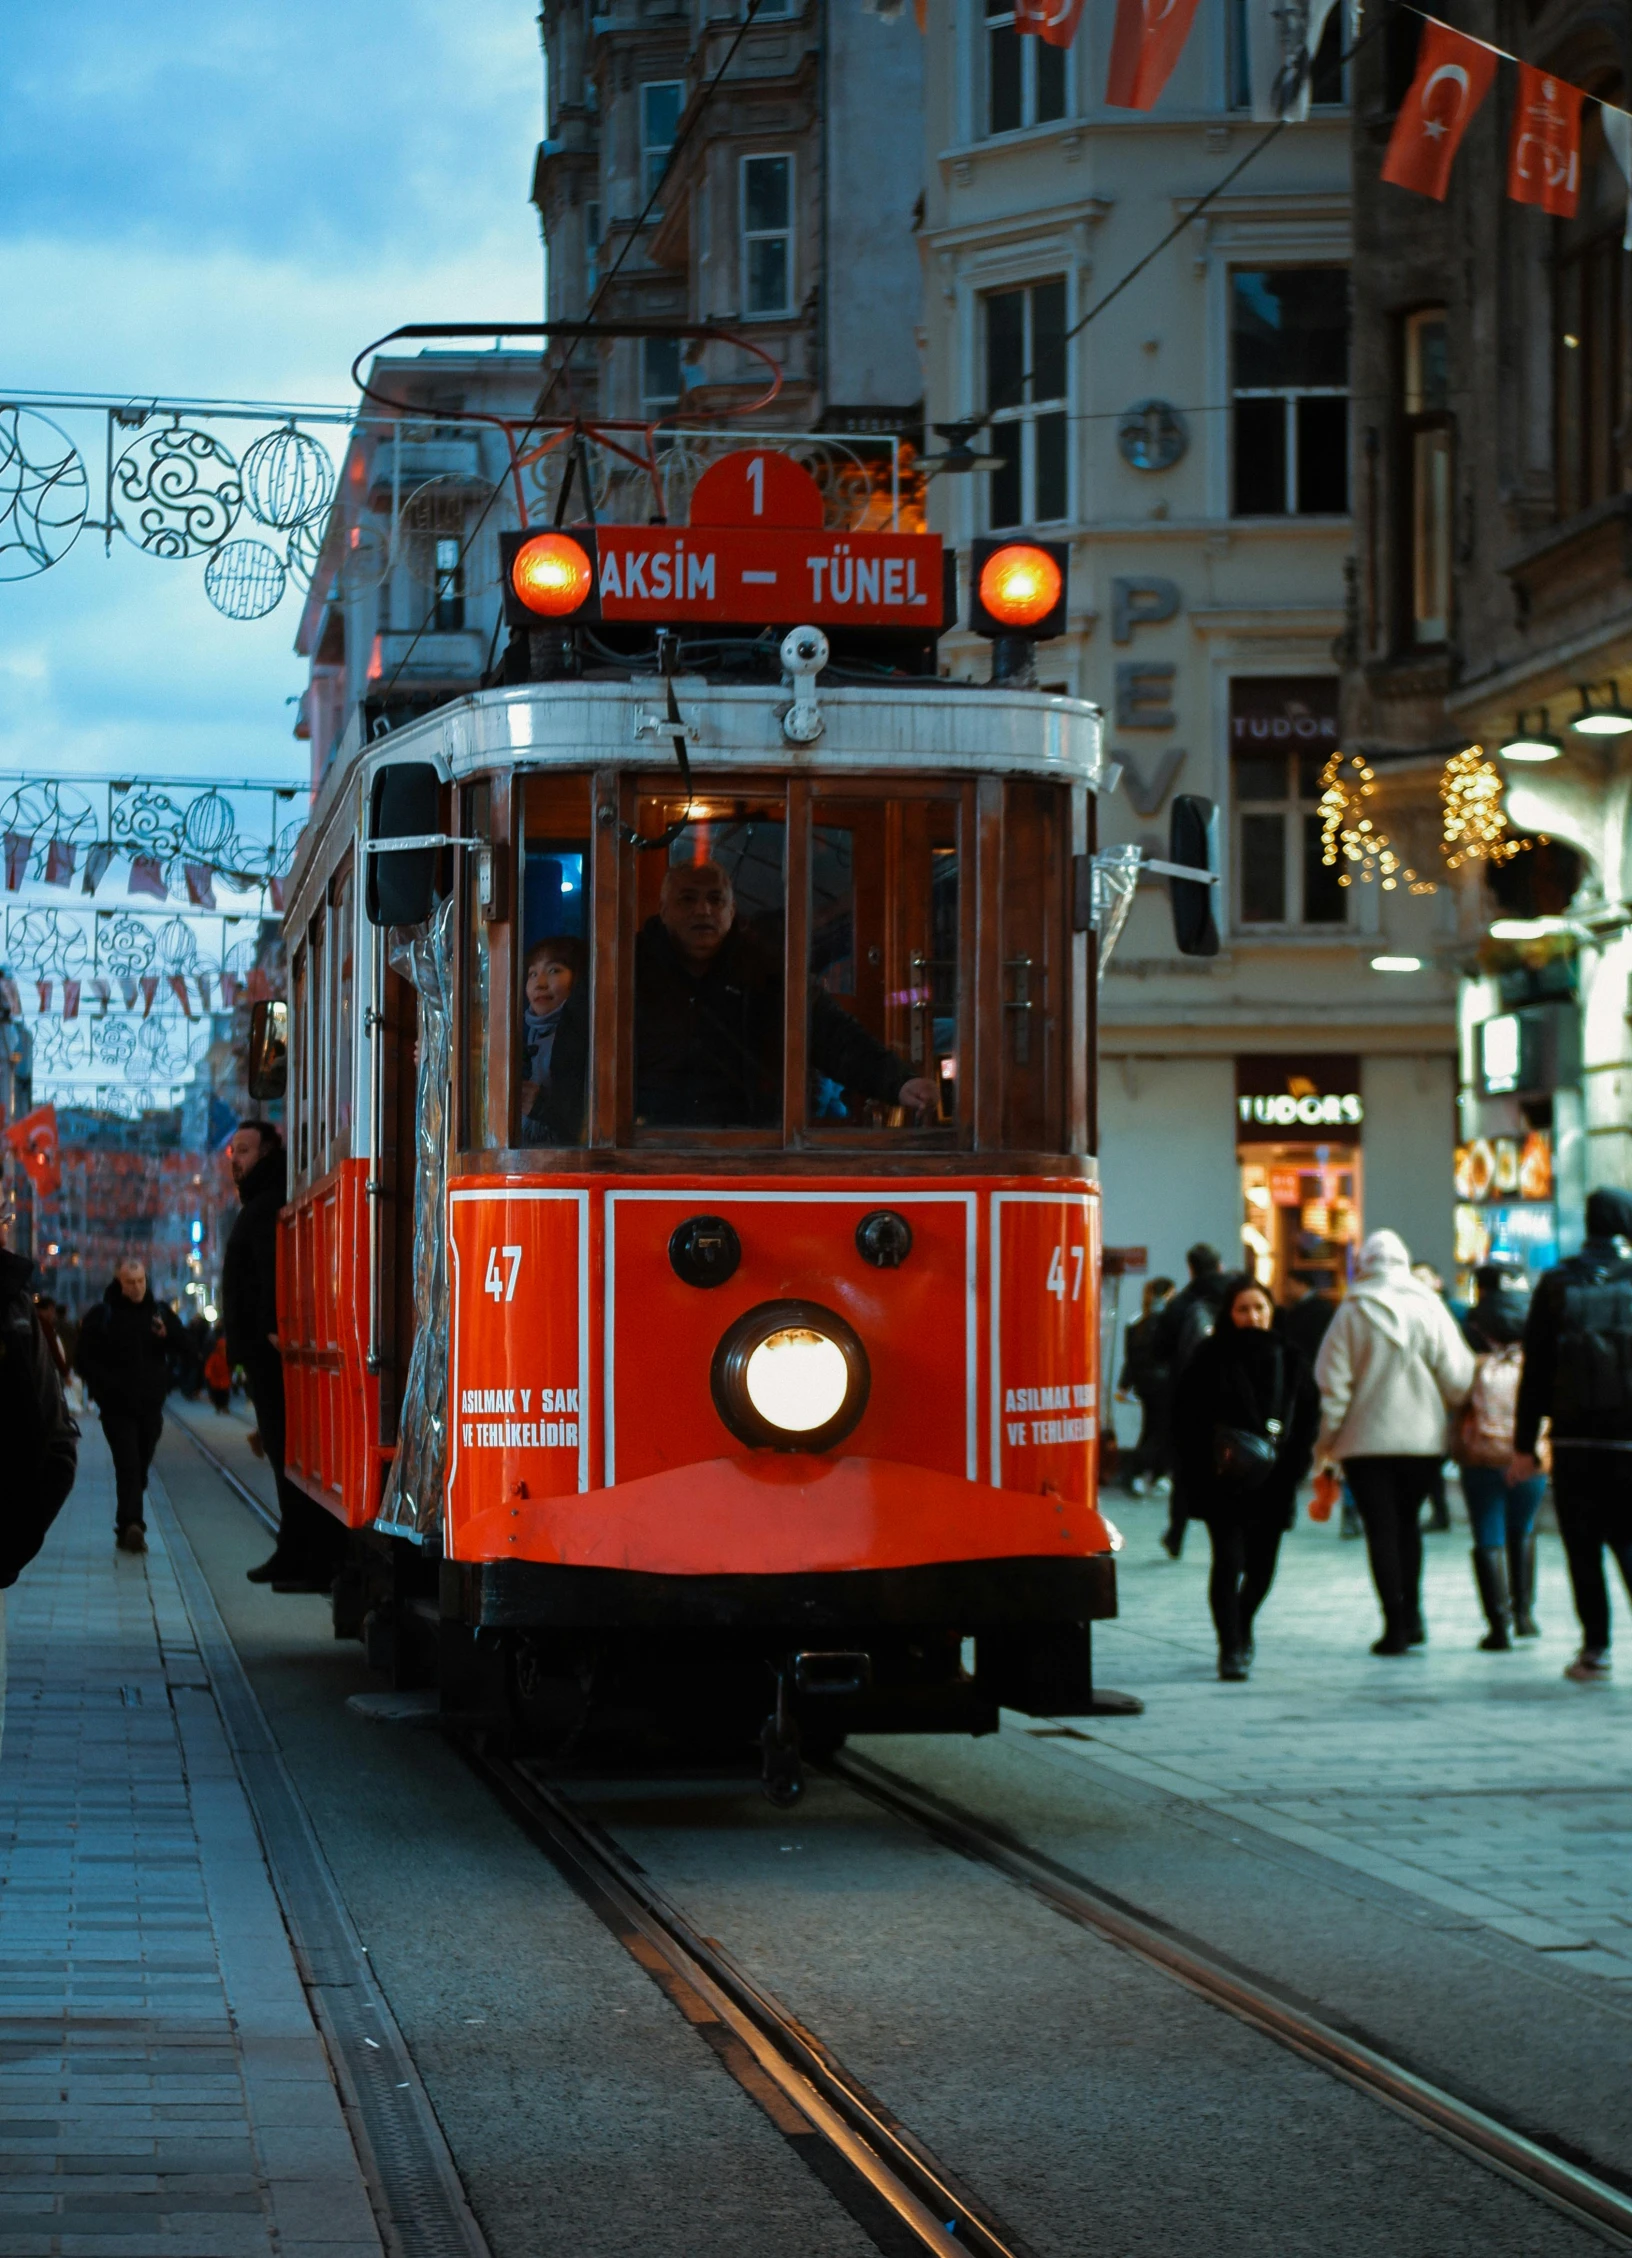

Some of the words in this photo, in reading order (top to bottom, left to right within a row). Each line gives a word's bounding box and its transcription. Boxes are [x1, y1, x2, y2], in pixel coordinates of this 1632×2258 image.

[745, 457, 764, 516] 1
[597, 539, 716, 600] AKSİM
[807, 545, 926, 606] TÜNEL
[1239, 1093, 1364, 1125] TUDORS
[484, 1245, 522, 1302] 47
[1046, 1245, 1084, 1301] 47
[462, 1389, 515, 1413] ASILMAK
[1005, 1385, 1071, 1412] ASILMAK
[462, 1423, 473, 1447] VE
[476, 1418, 578, 1447] TEHLİKELİDİR
[1007, 1422, 1026, 1446] VE
